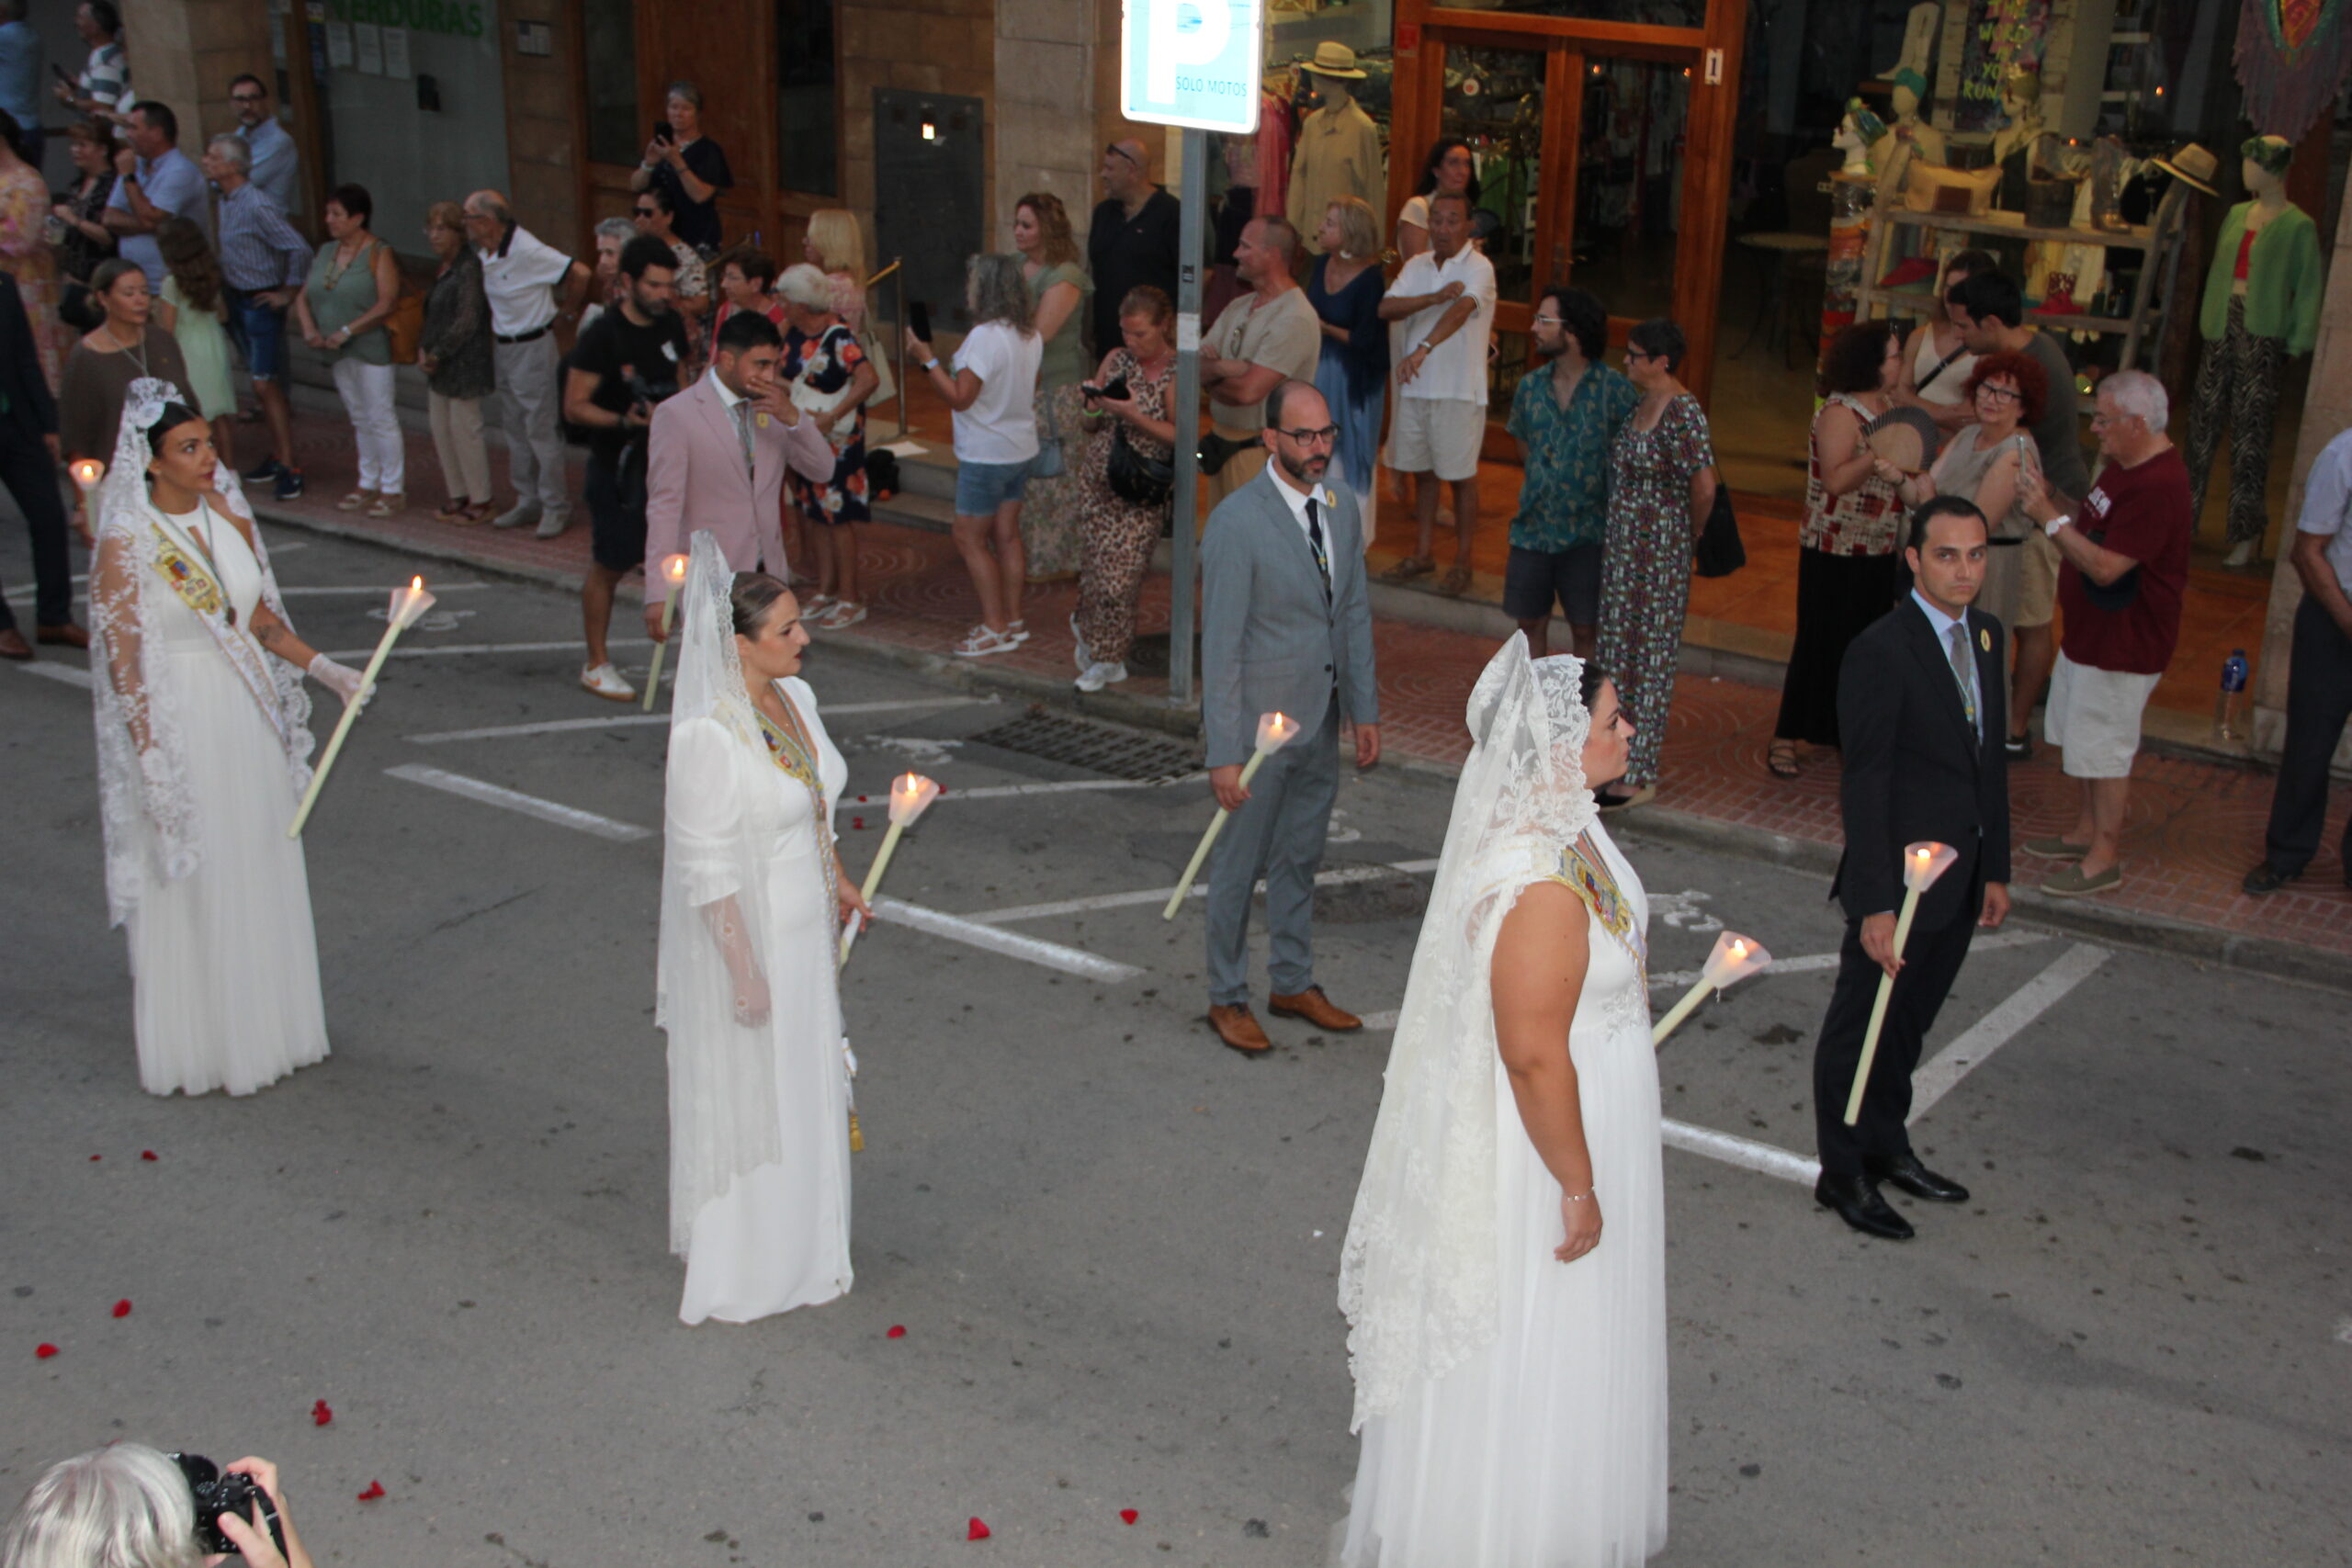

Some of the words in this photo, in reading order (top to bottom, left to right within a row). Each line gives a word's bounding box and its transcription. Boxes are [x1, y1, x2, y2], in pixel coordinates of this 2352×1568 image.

[1147, 0, 1231, 105] P
[1710, 57, 1717, 75] 1
[1175, 76, 1204, 92] SOLO
[1208, 80, 1247, 97] MOTOS
